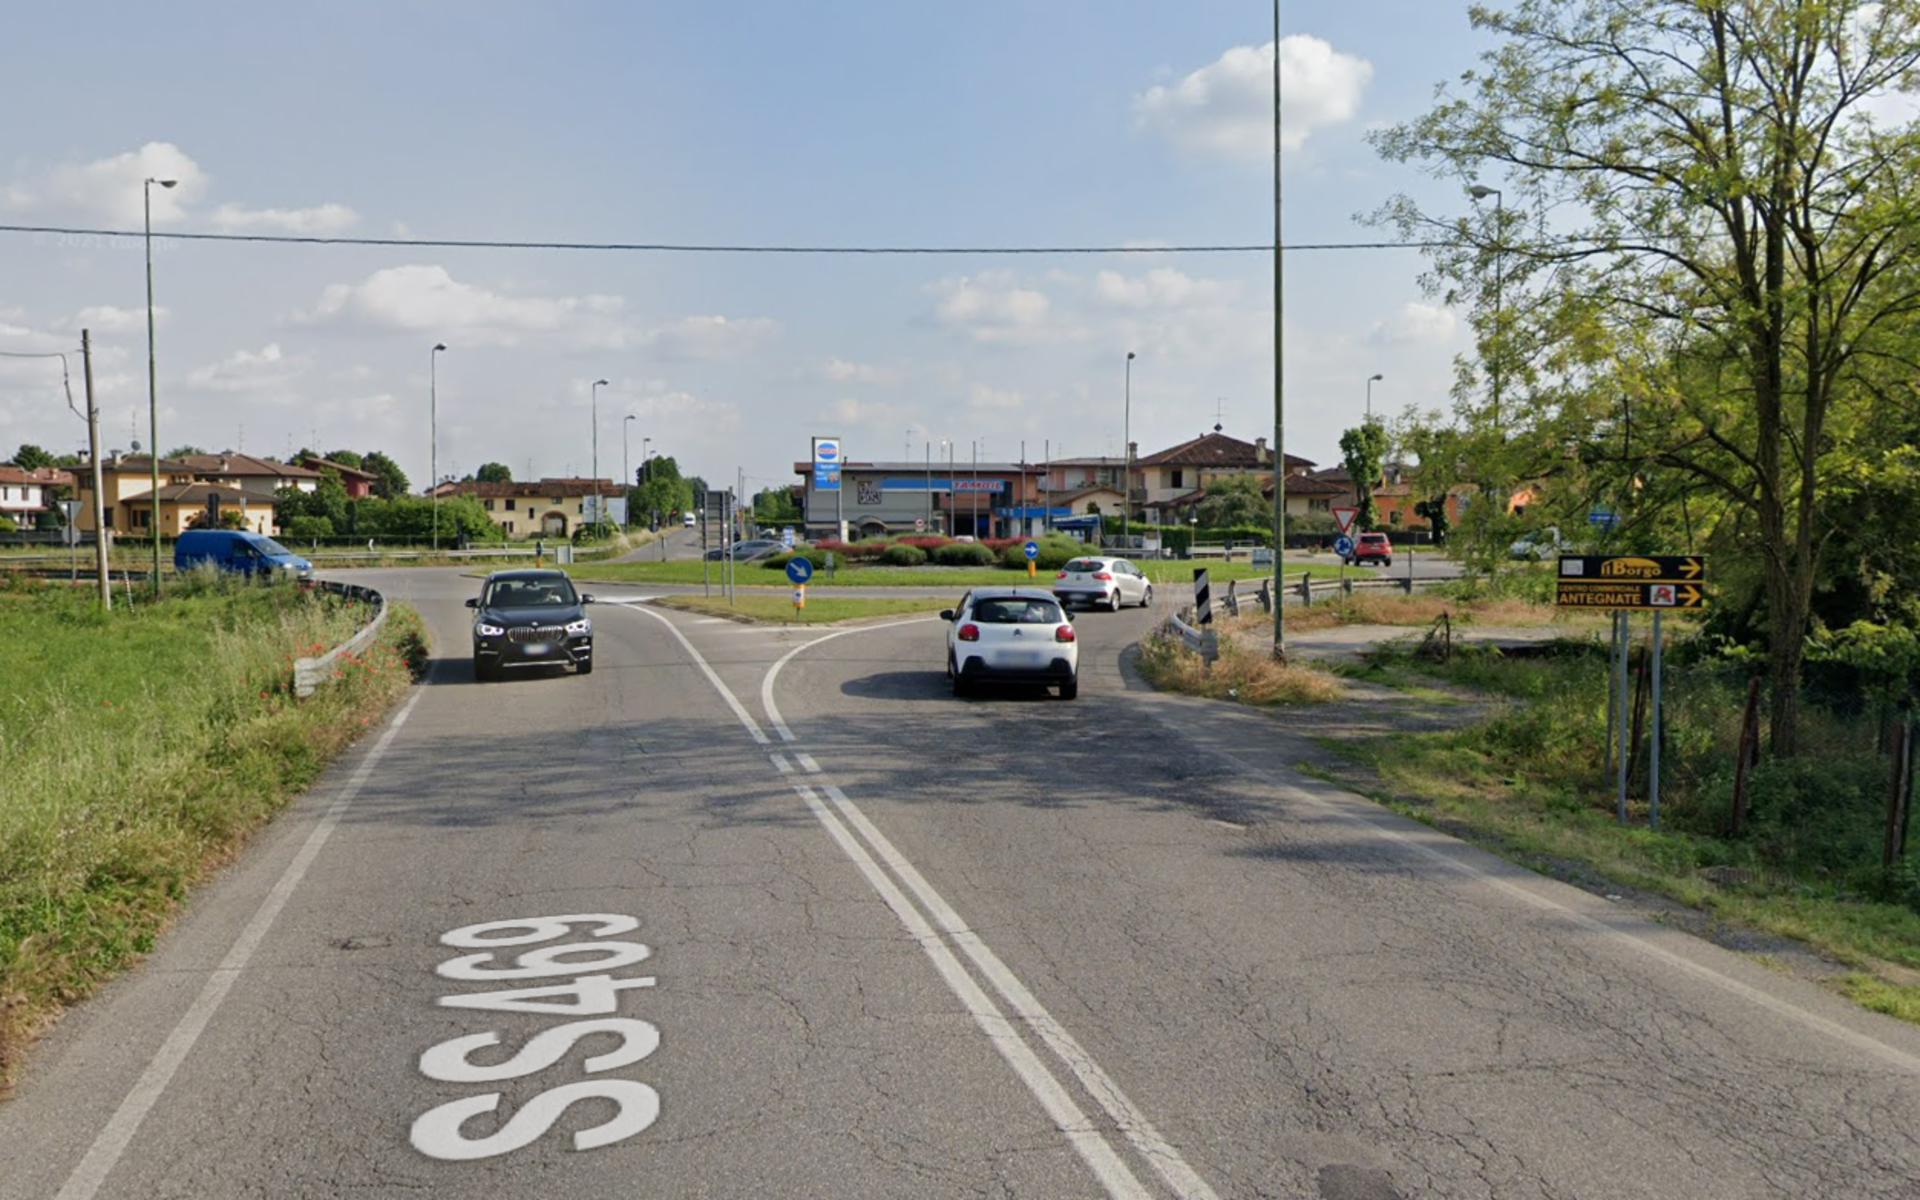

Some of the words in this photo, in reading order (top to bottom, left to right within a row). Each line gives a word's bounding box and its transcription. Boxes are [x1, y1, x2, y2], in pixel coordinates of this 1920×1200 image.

[954, 481, 1001, 490] TAMOIL
[1613, 560, 1661, 577] Borgo
[1560, 593, 1641, 604] ANTEGNATE
